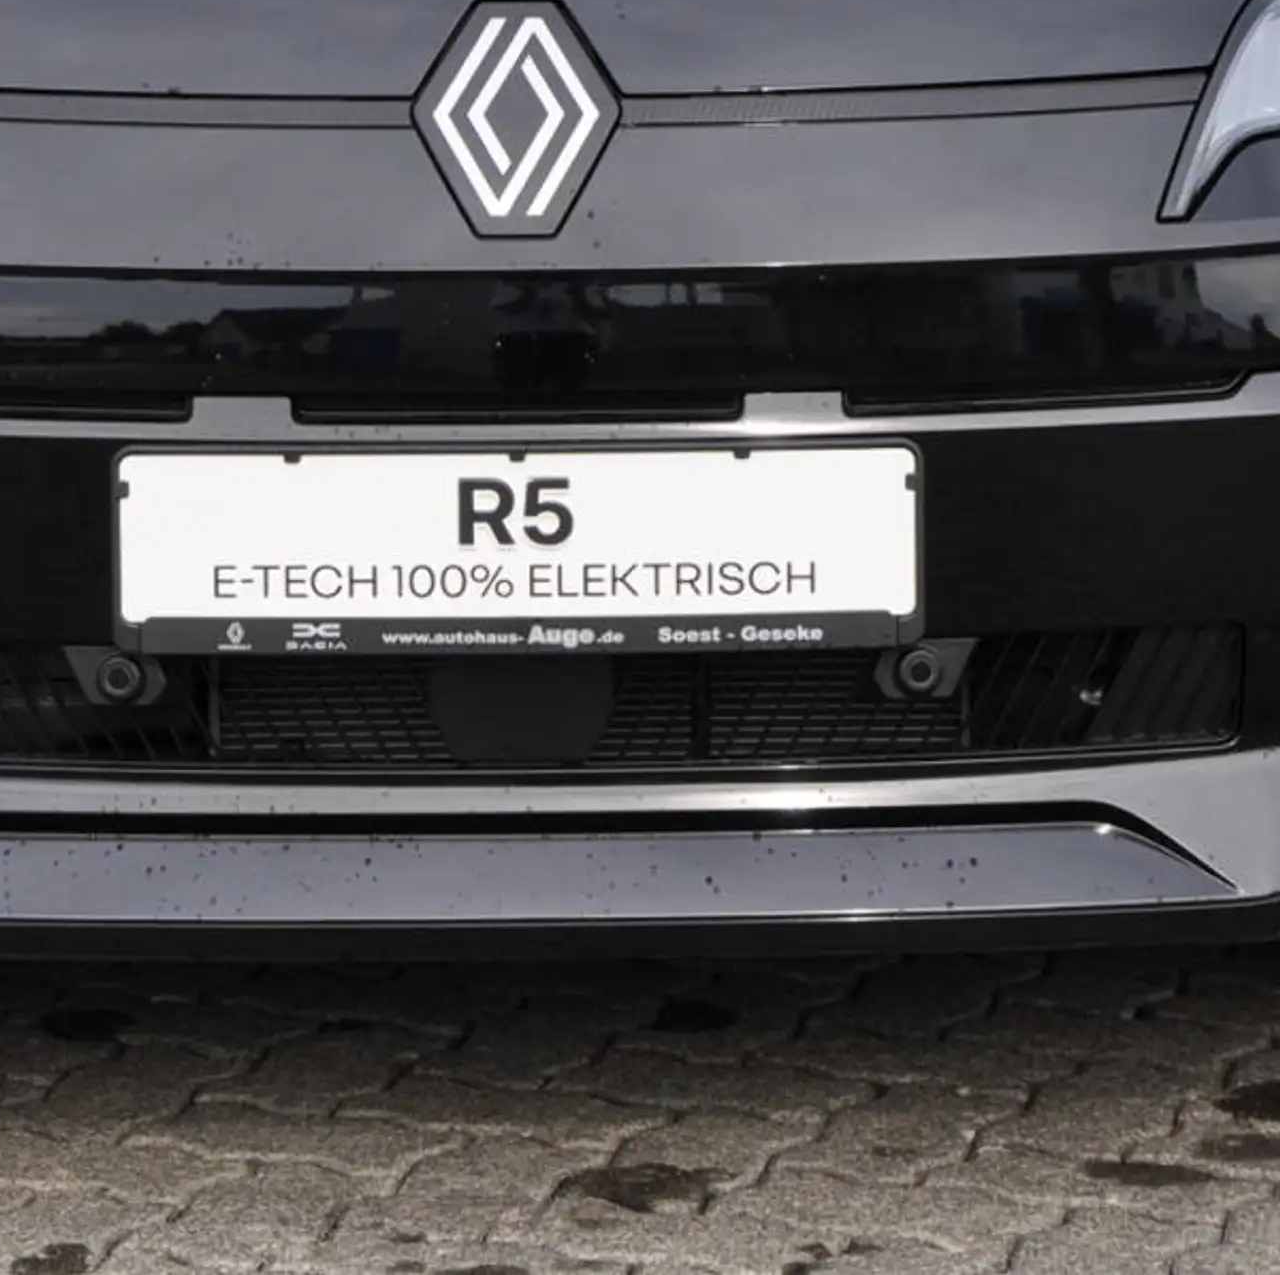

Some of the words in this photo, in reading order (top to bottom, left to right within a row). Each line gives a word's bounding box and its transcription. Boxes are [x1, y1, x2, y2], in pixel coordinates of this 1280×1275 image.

[457, 477, 575, 546] R5
[213, 564, 378, 599] E-TECH
[391, 564, 515, 599] 100%
[529, 560, 816, 598] ELEKTRISCH
[657, 626, 722, 643] Soest
[739, 624, 824, 643] Geseke
